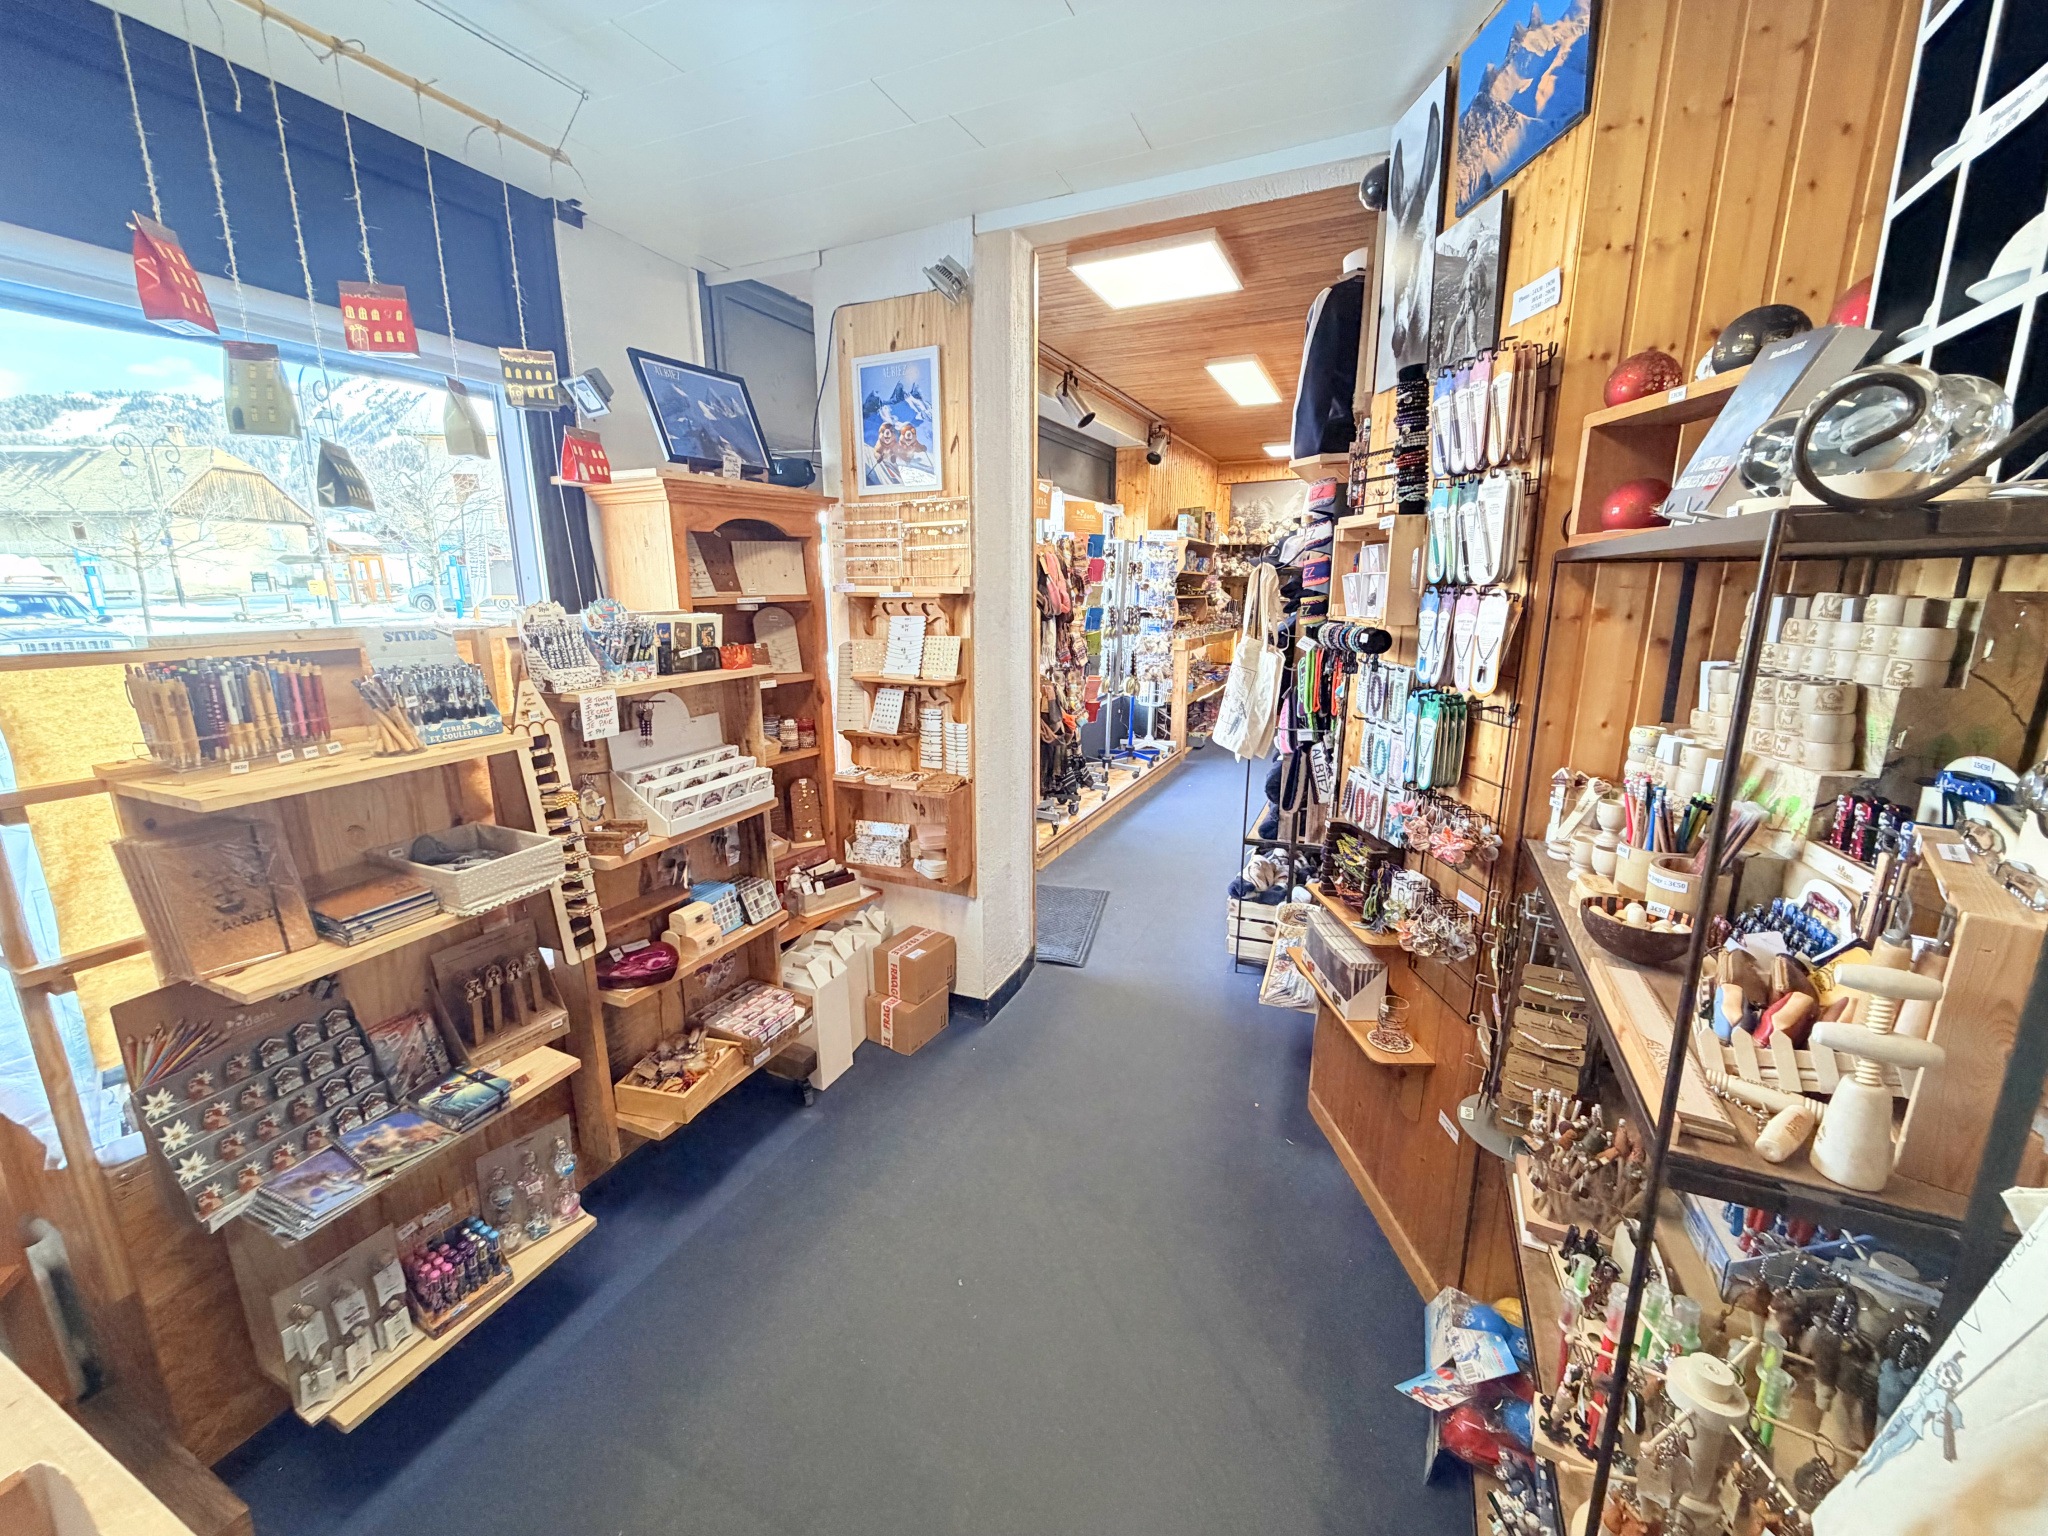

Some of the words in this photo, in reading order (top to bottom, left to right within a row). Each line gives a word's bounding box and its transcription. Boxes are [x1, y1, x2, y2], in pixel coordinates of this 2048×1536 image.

[383, 630, 438, 643] STYLOS
[440, 723, 472, 734] TERRES
[429, 734, 441, 743] ET
[442, 728, 484, 741] COULEURS
[1311, 748, 1330, 795] ALBIEZ
[1668, 880, 1687, 890] 3€50
